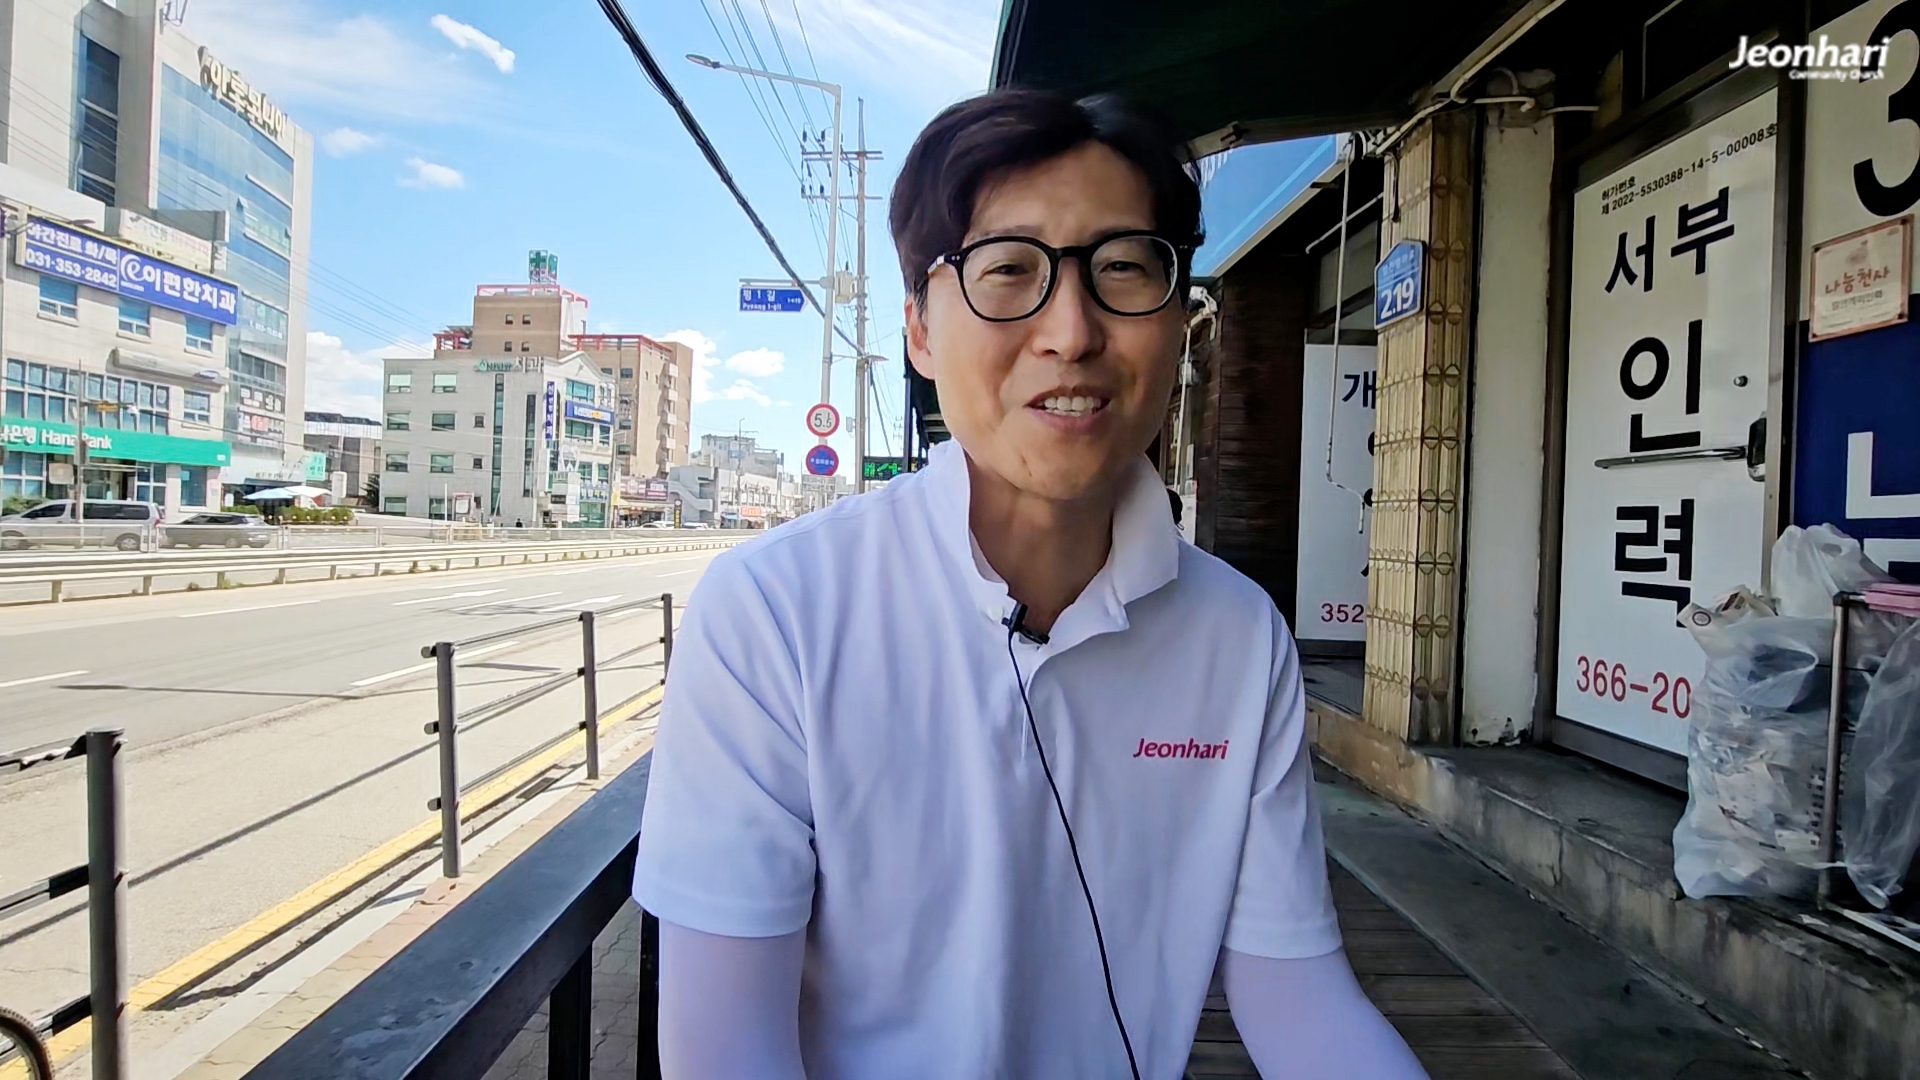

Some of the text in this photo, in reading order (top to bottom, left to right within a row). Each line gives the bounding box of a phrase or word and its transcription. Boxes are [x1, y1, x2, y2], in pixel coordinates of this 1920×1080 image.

[1602, 176, 1636, 201] 허가번호
[1604, 186, 1735, 294] 서부
[1321, 602, 1365, 623] 352
[1132, 737, 1230, 760] Jeonhari
